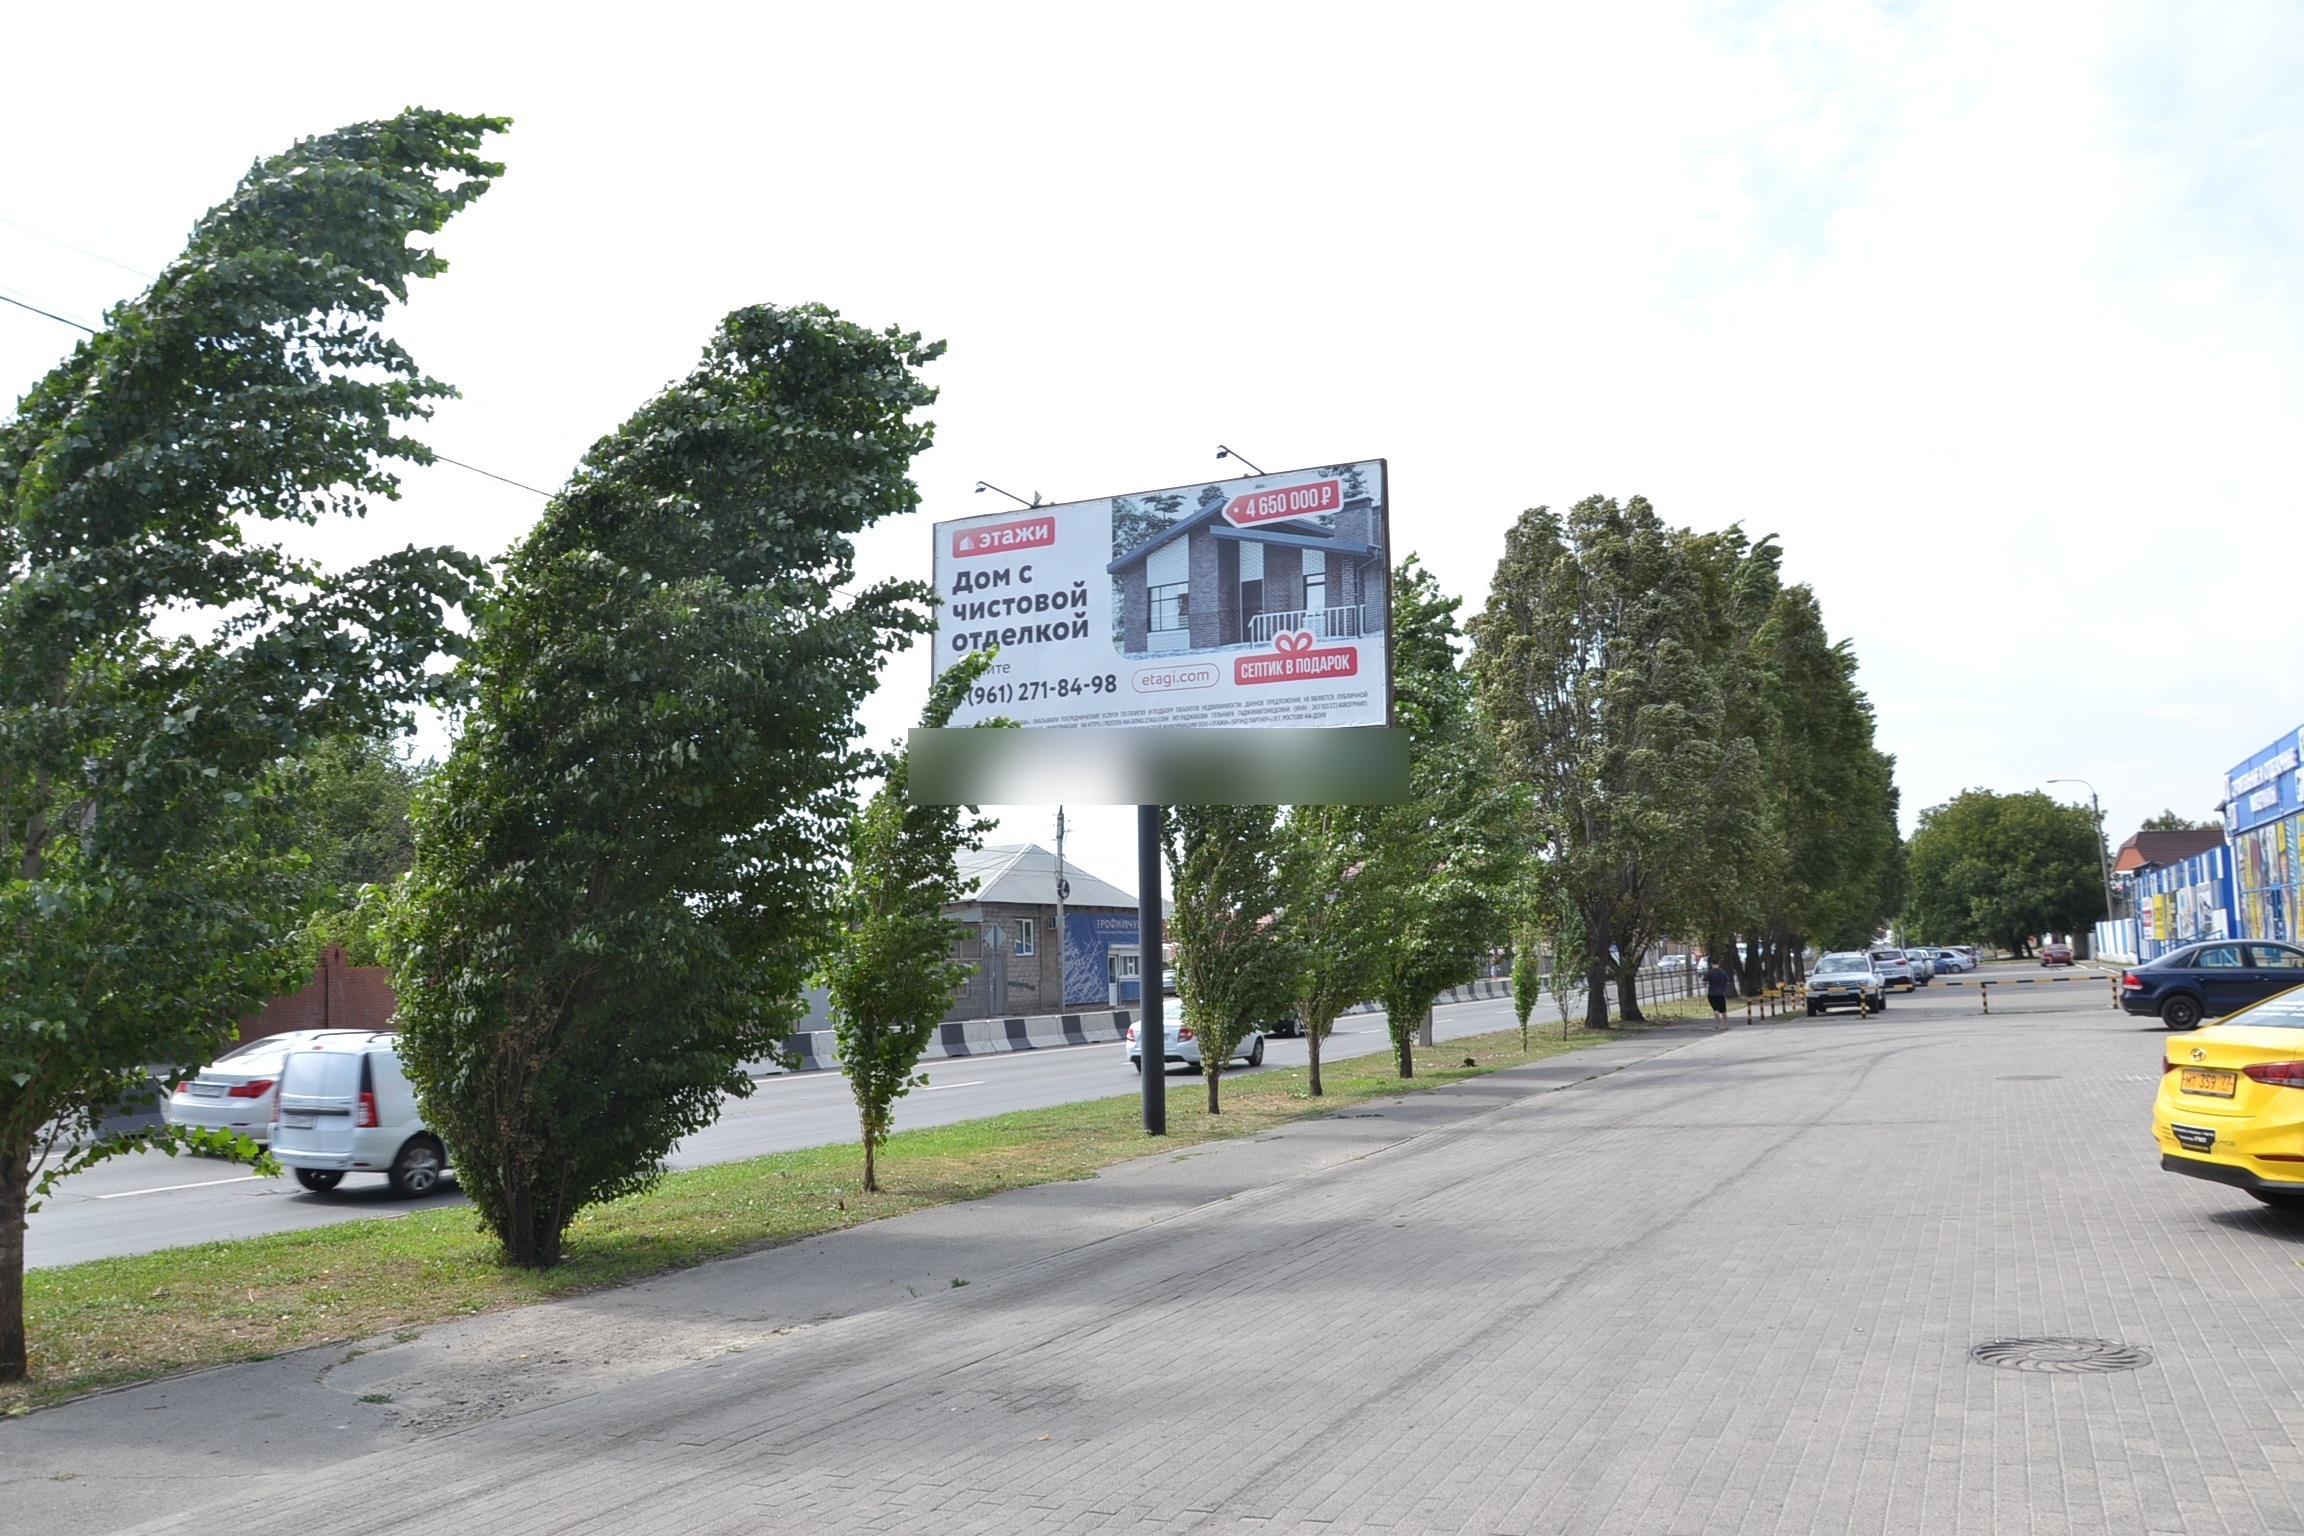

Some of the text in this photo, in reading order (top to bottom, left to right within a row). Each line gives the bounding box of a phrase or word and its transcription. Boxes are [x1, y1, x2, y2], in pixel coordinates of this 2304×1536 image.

[1246, 499, 1256, 517] 4
[1259, 493, 1287, 516] 650
[1290, 488, 1319, 511] 000
[979, 524, 1048, 548] этажи
[1018, 564, 1033, 584] с
[952, 580, 1088, 621] чистовой
[951, 611, 1089, 652] отделкой
[1141, 670, 1210, 688] etagi.com
[1240, 654, 1350, 679] СЕПТИК В ПОДАРОК
[967, 673, 1117, 707] (961) 271-84-98
[1102, 711, 1119, 719] УСЛУГИ
[1245, 700, 1264, 708] ДАННОЕ
[1266, 696, 1301, 706] ПРЕДЛОЖЕНИЕ
[1336, 690, 1368, 700] ПУБЛИЧНОЙ
